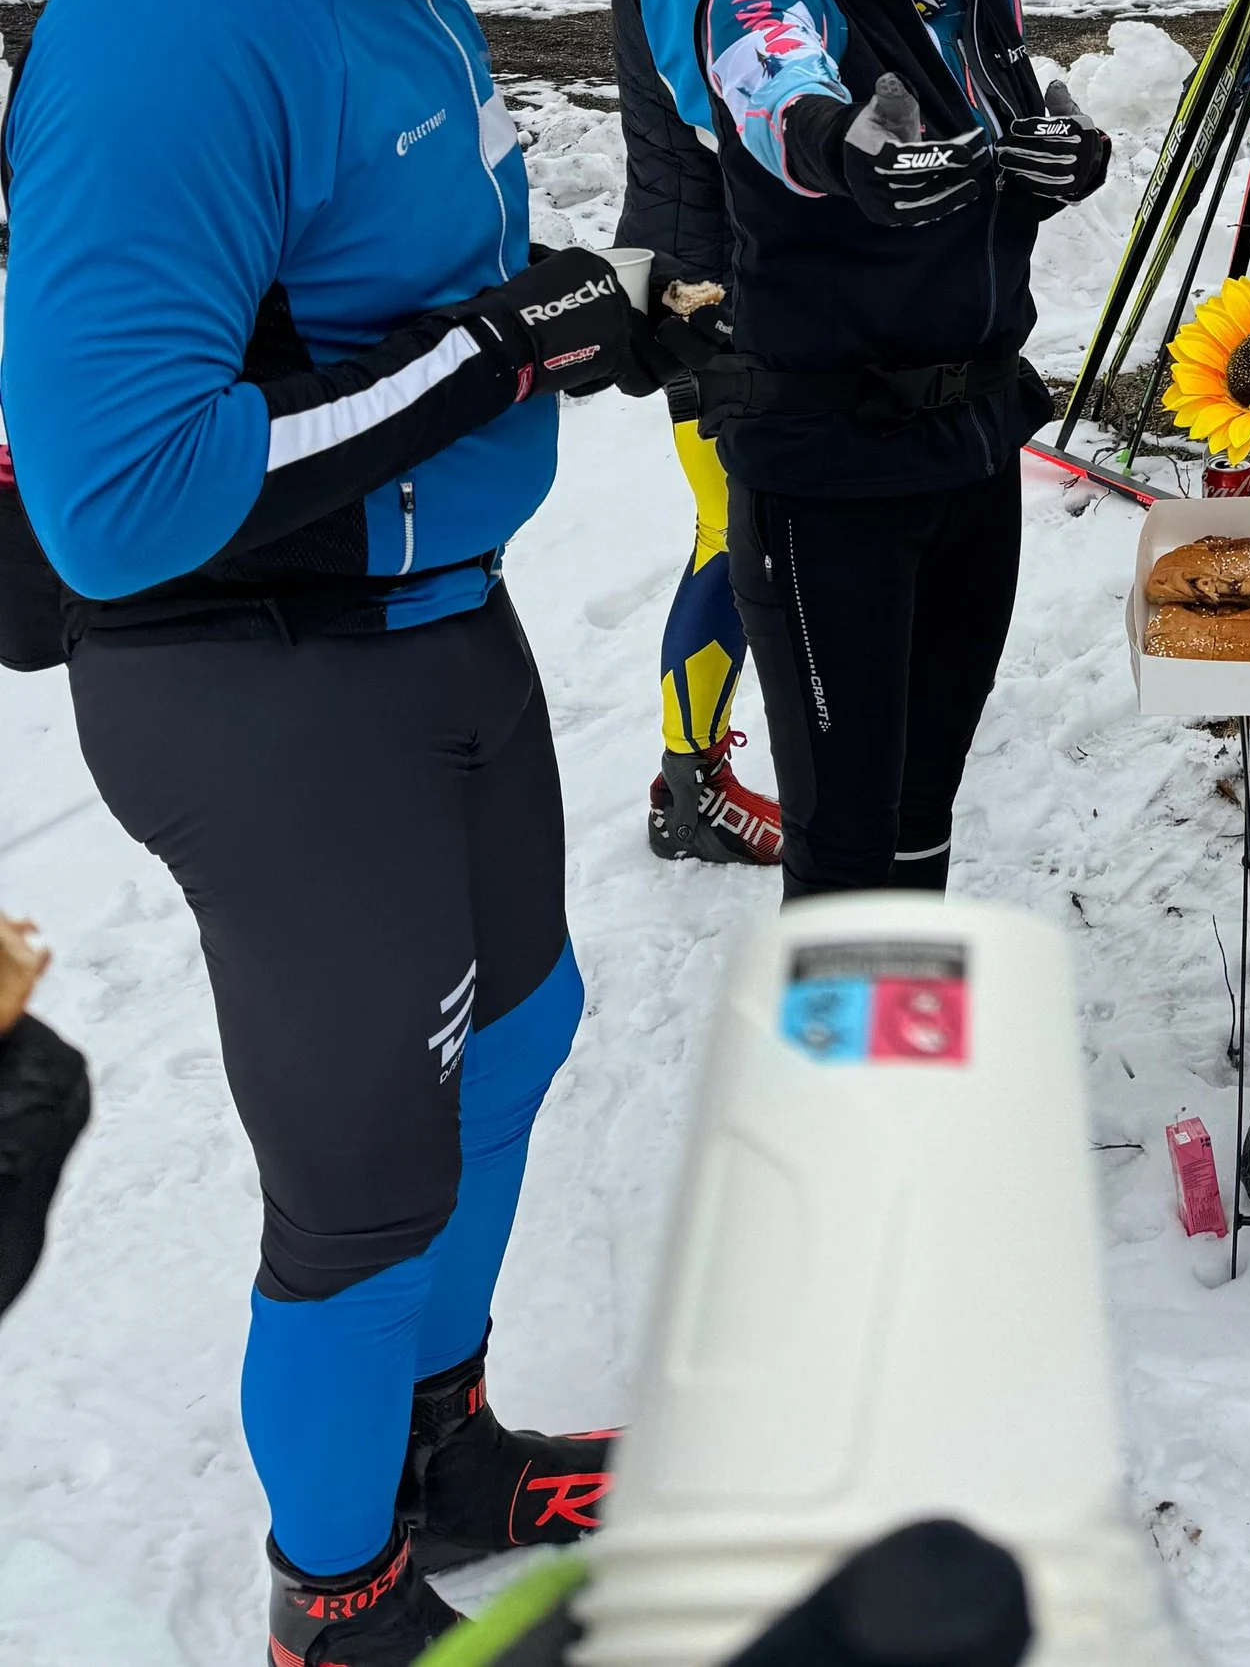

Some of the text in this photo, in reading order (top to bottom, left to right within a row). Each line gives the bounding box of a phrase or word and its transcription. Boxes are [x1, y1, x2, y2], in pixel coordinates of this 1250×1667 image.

[1140, 119, 1187, 223] FISCHER
[811, 675, 830, 722] CRAFT
[698, 786, 784, 856] alpin
